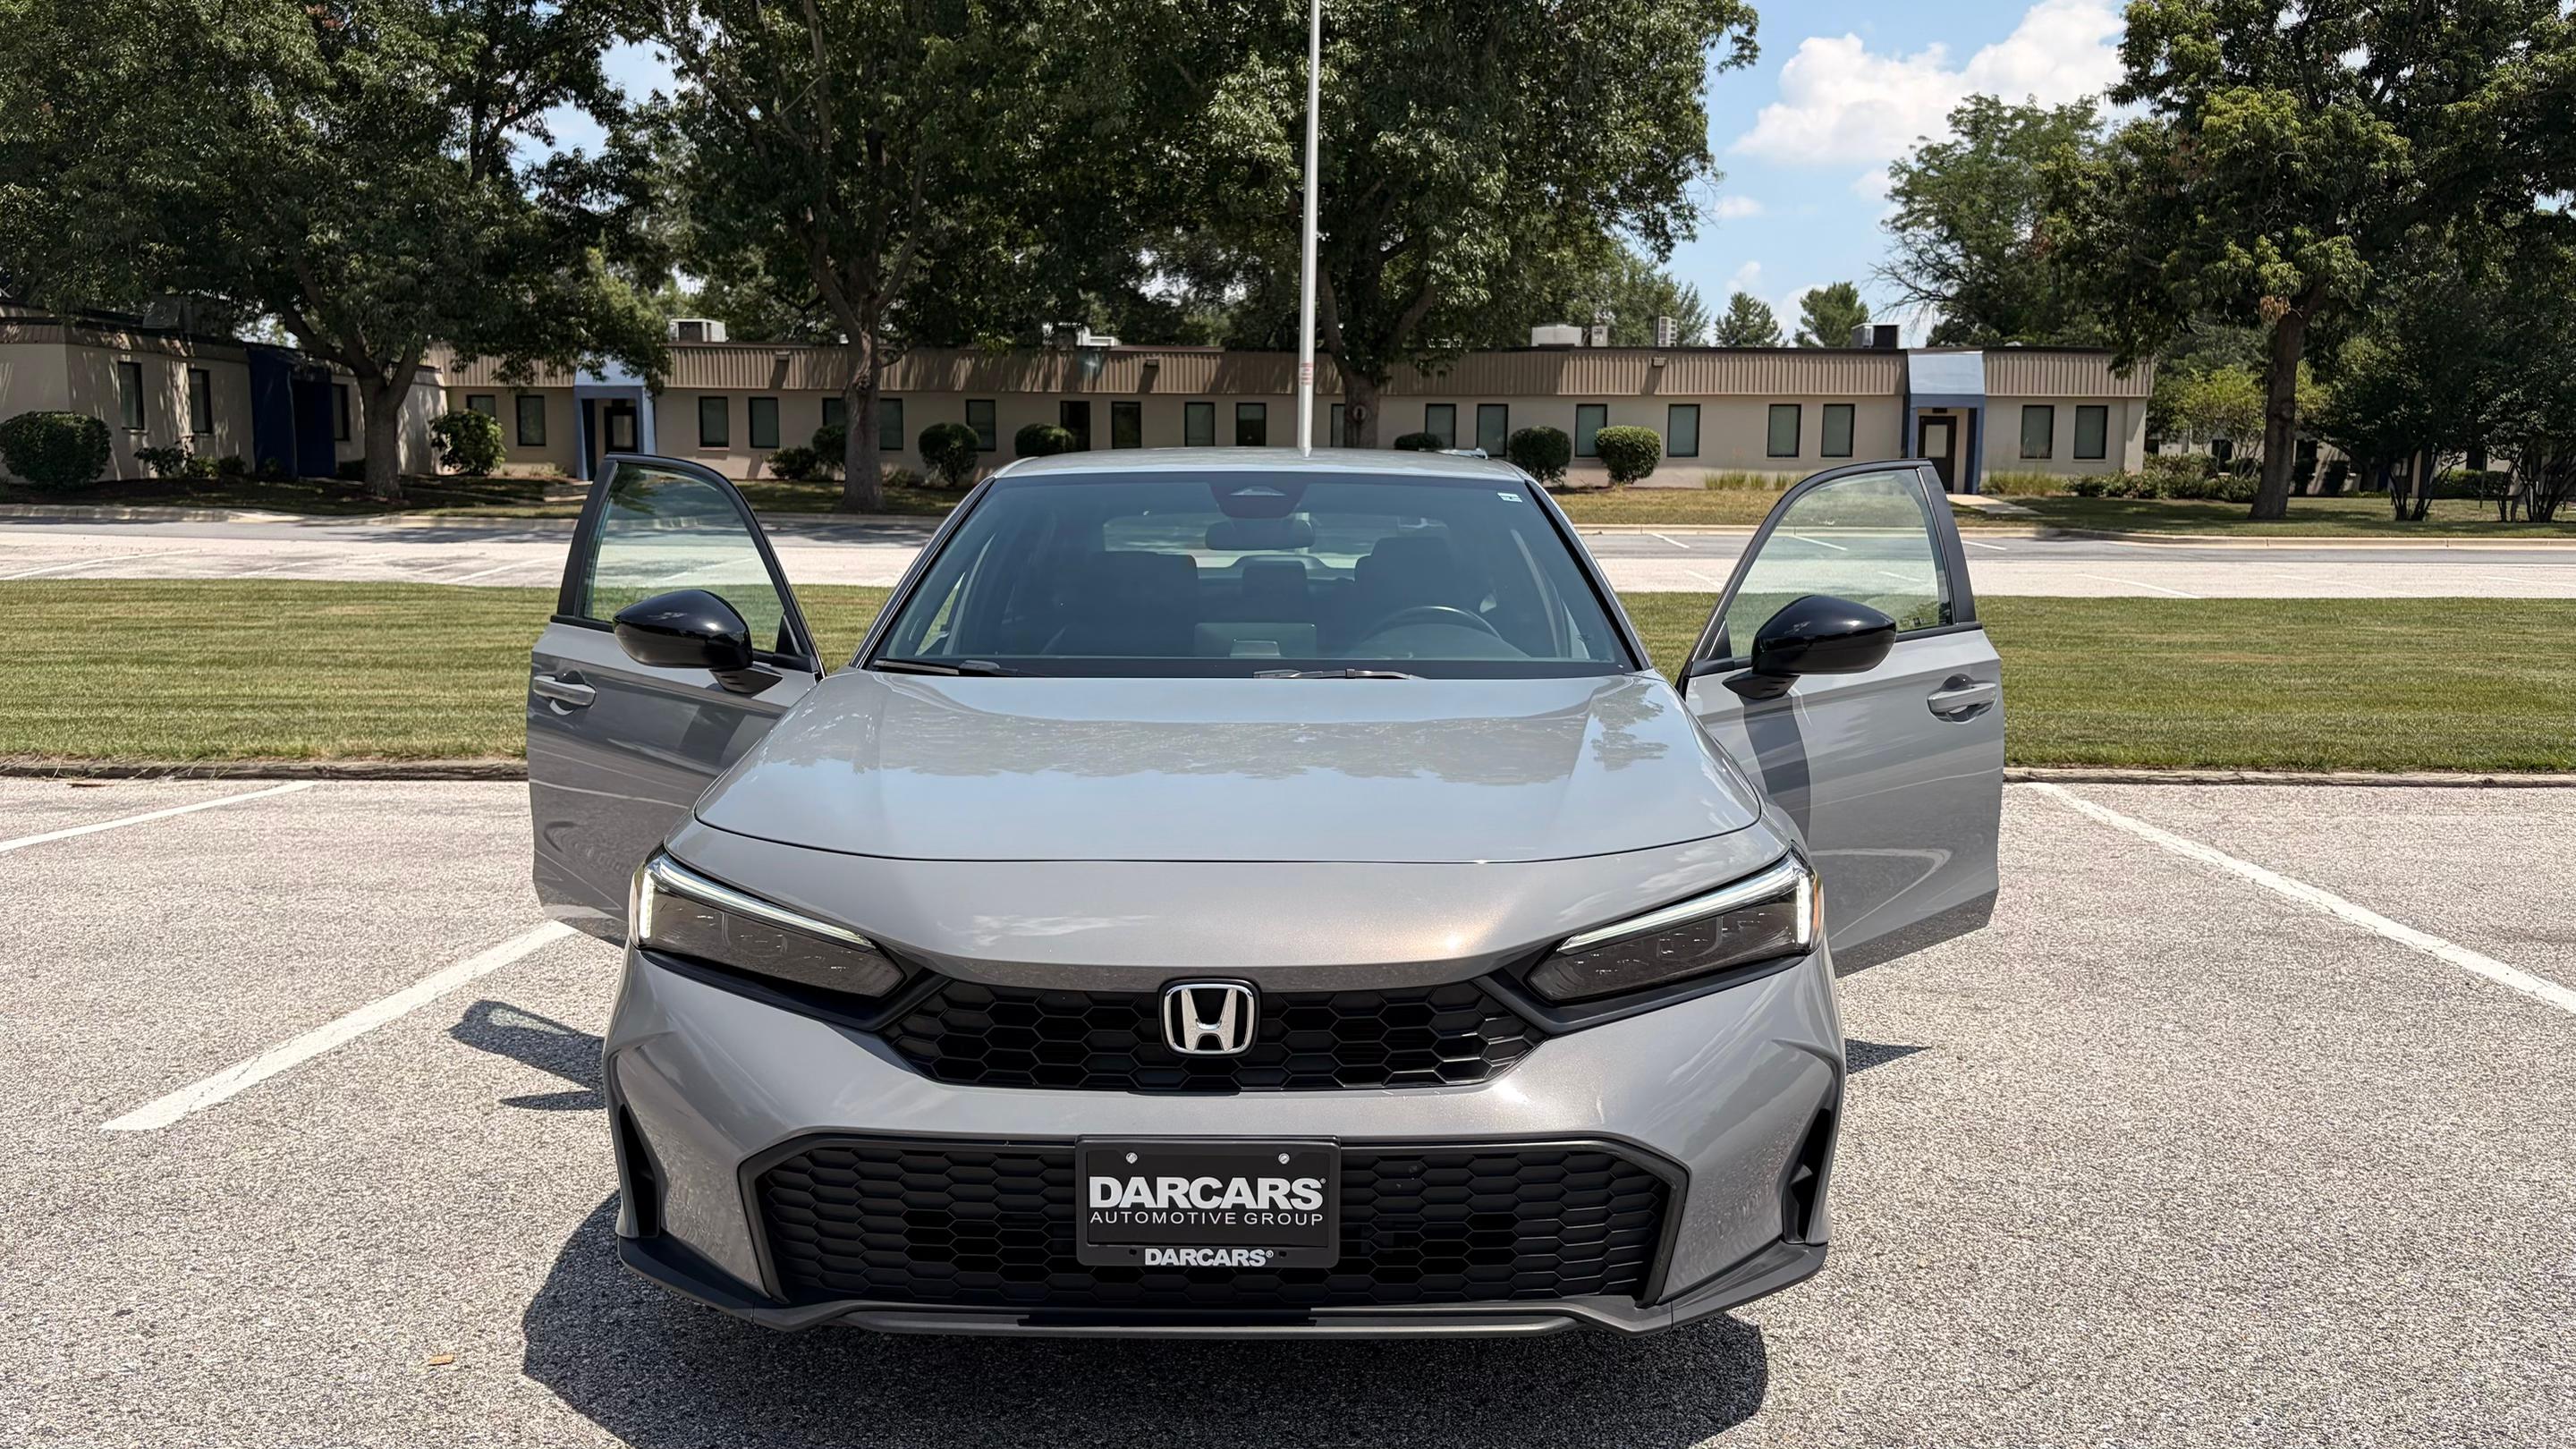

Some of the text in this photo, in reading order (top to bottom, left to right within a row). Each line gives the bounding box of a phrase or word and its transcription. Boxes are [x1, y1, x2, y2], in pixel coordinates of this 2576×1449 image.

[1182, 988, 1237, 1051] H
[1089, 1176, 1324, 1210] DARCARS
[1089, 1211, 1324, 1226] AUTOMOTIVE GROUP
